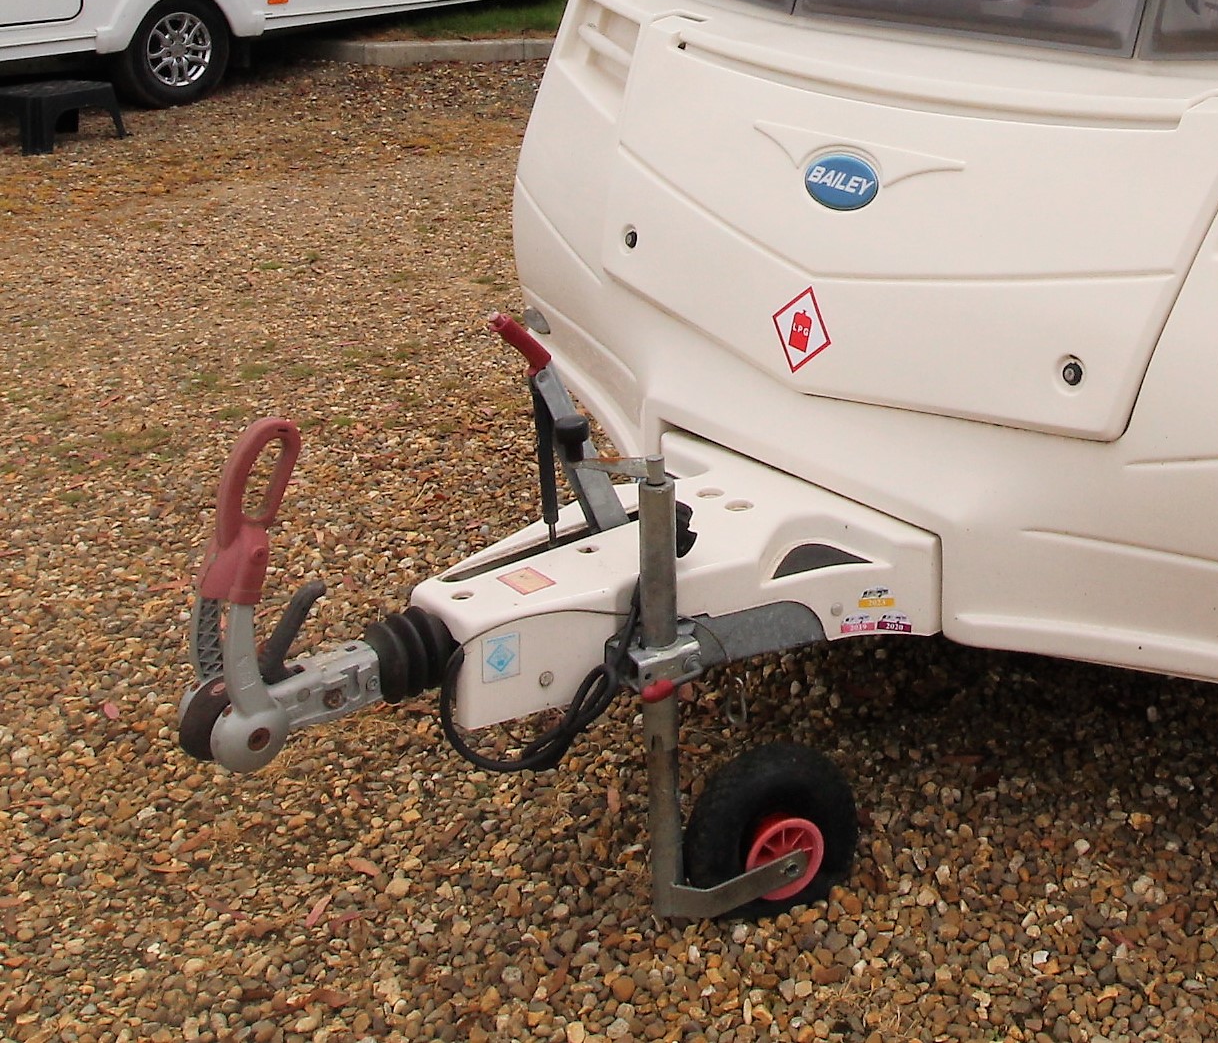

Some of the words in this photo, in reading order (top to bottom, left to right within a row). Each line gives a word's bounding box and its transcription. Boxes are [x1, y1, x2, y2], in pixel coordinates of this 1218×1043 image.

[807, 165, 875, 196] BAILEY
[792, 322, 809, 337] LPG
[886, 623, 904, 631] 2020
